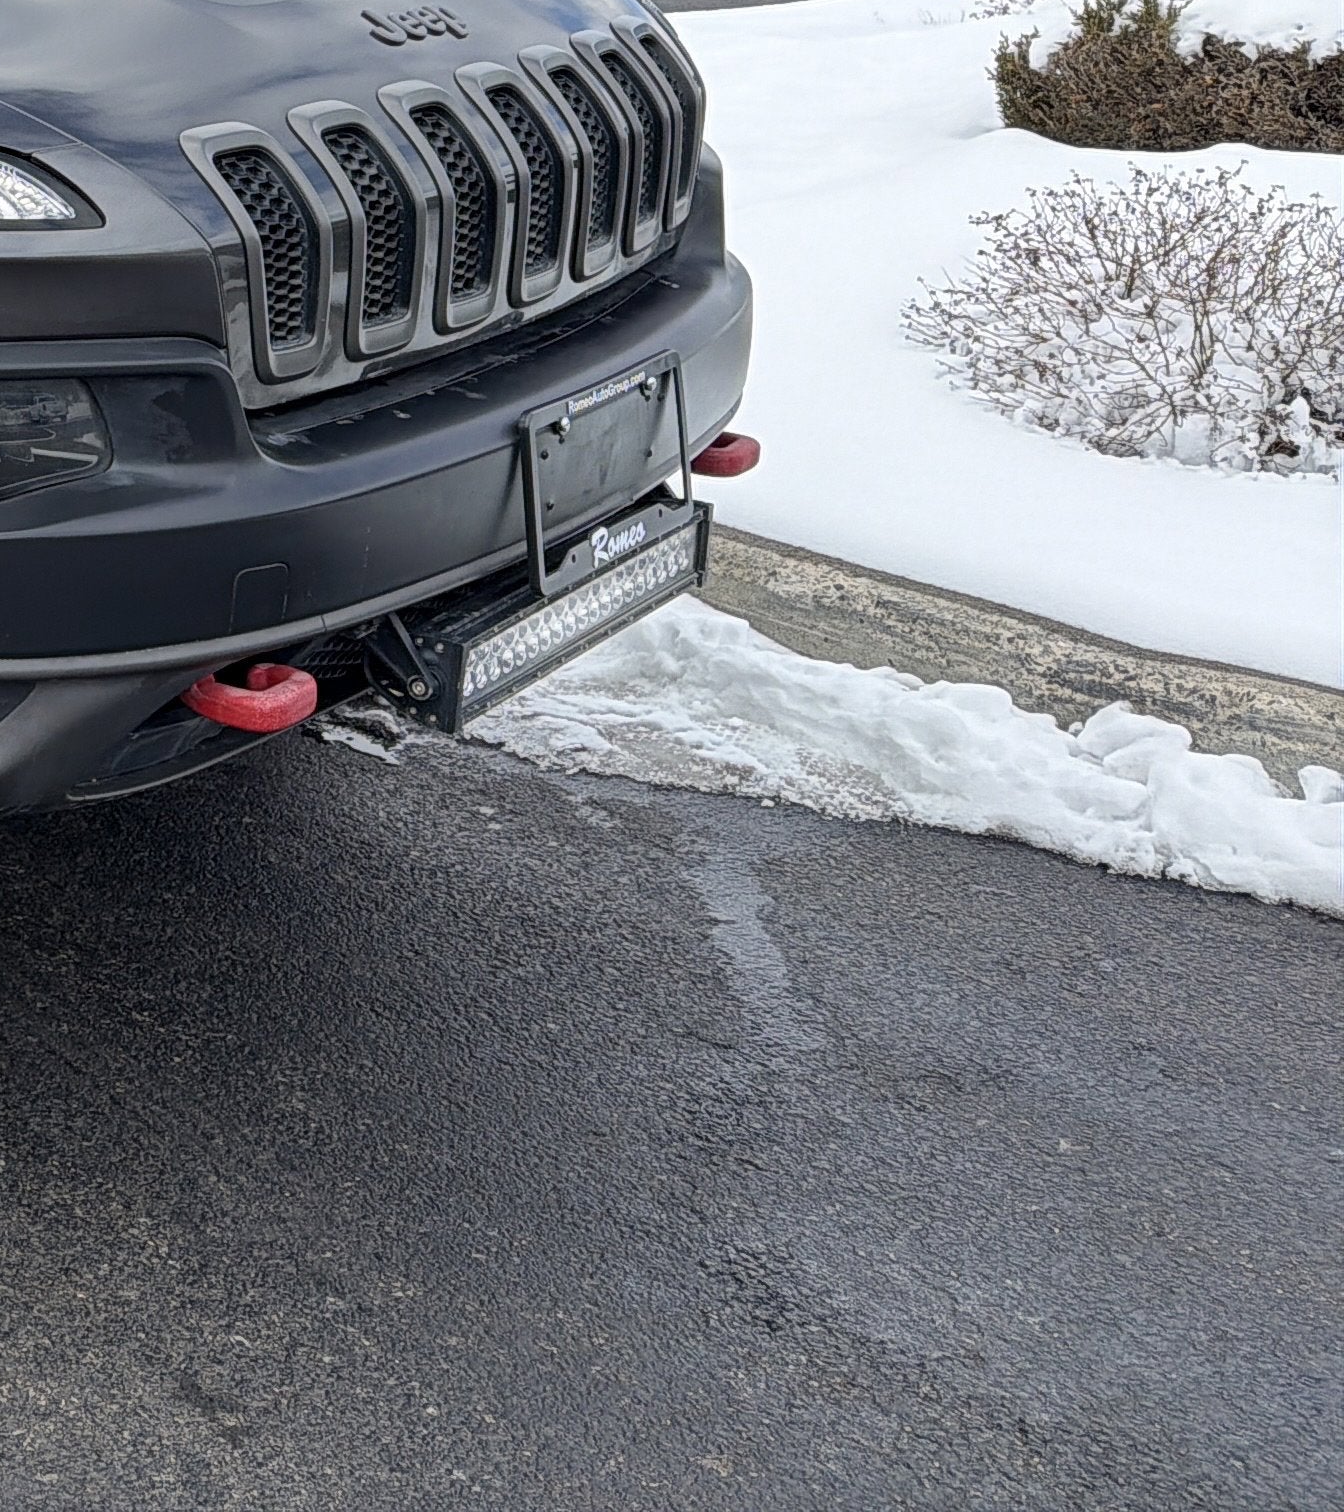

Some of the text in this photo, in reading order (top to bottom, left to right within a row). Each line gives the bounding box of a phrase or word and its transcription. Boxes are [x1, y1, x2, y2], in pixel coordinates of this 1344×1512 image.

[360, 6, 470, 47] Jeep
[568, 371, 646, 414] RomeoAutoGroup.com
[591, 521, 646, 568] Romeo
